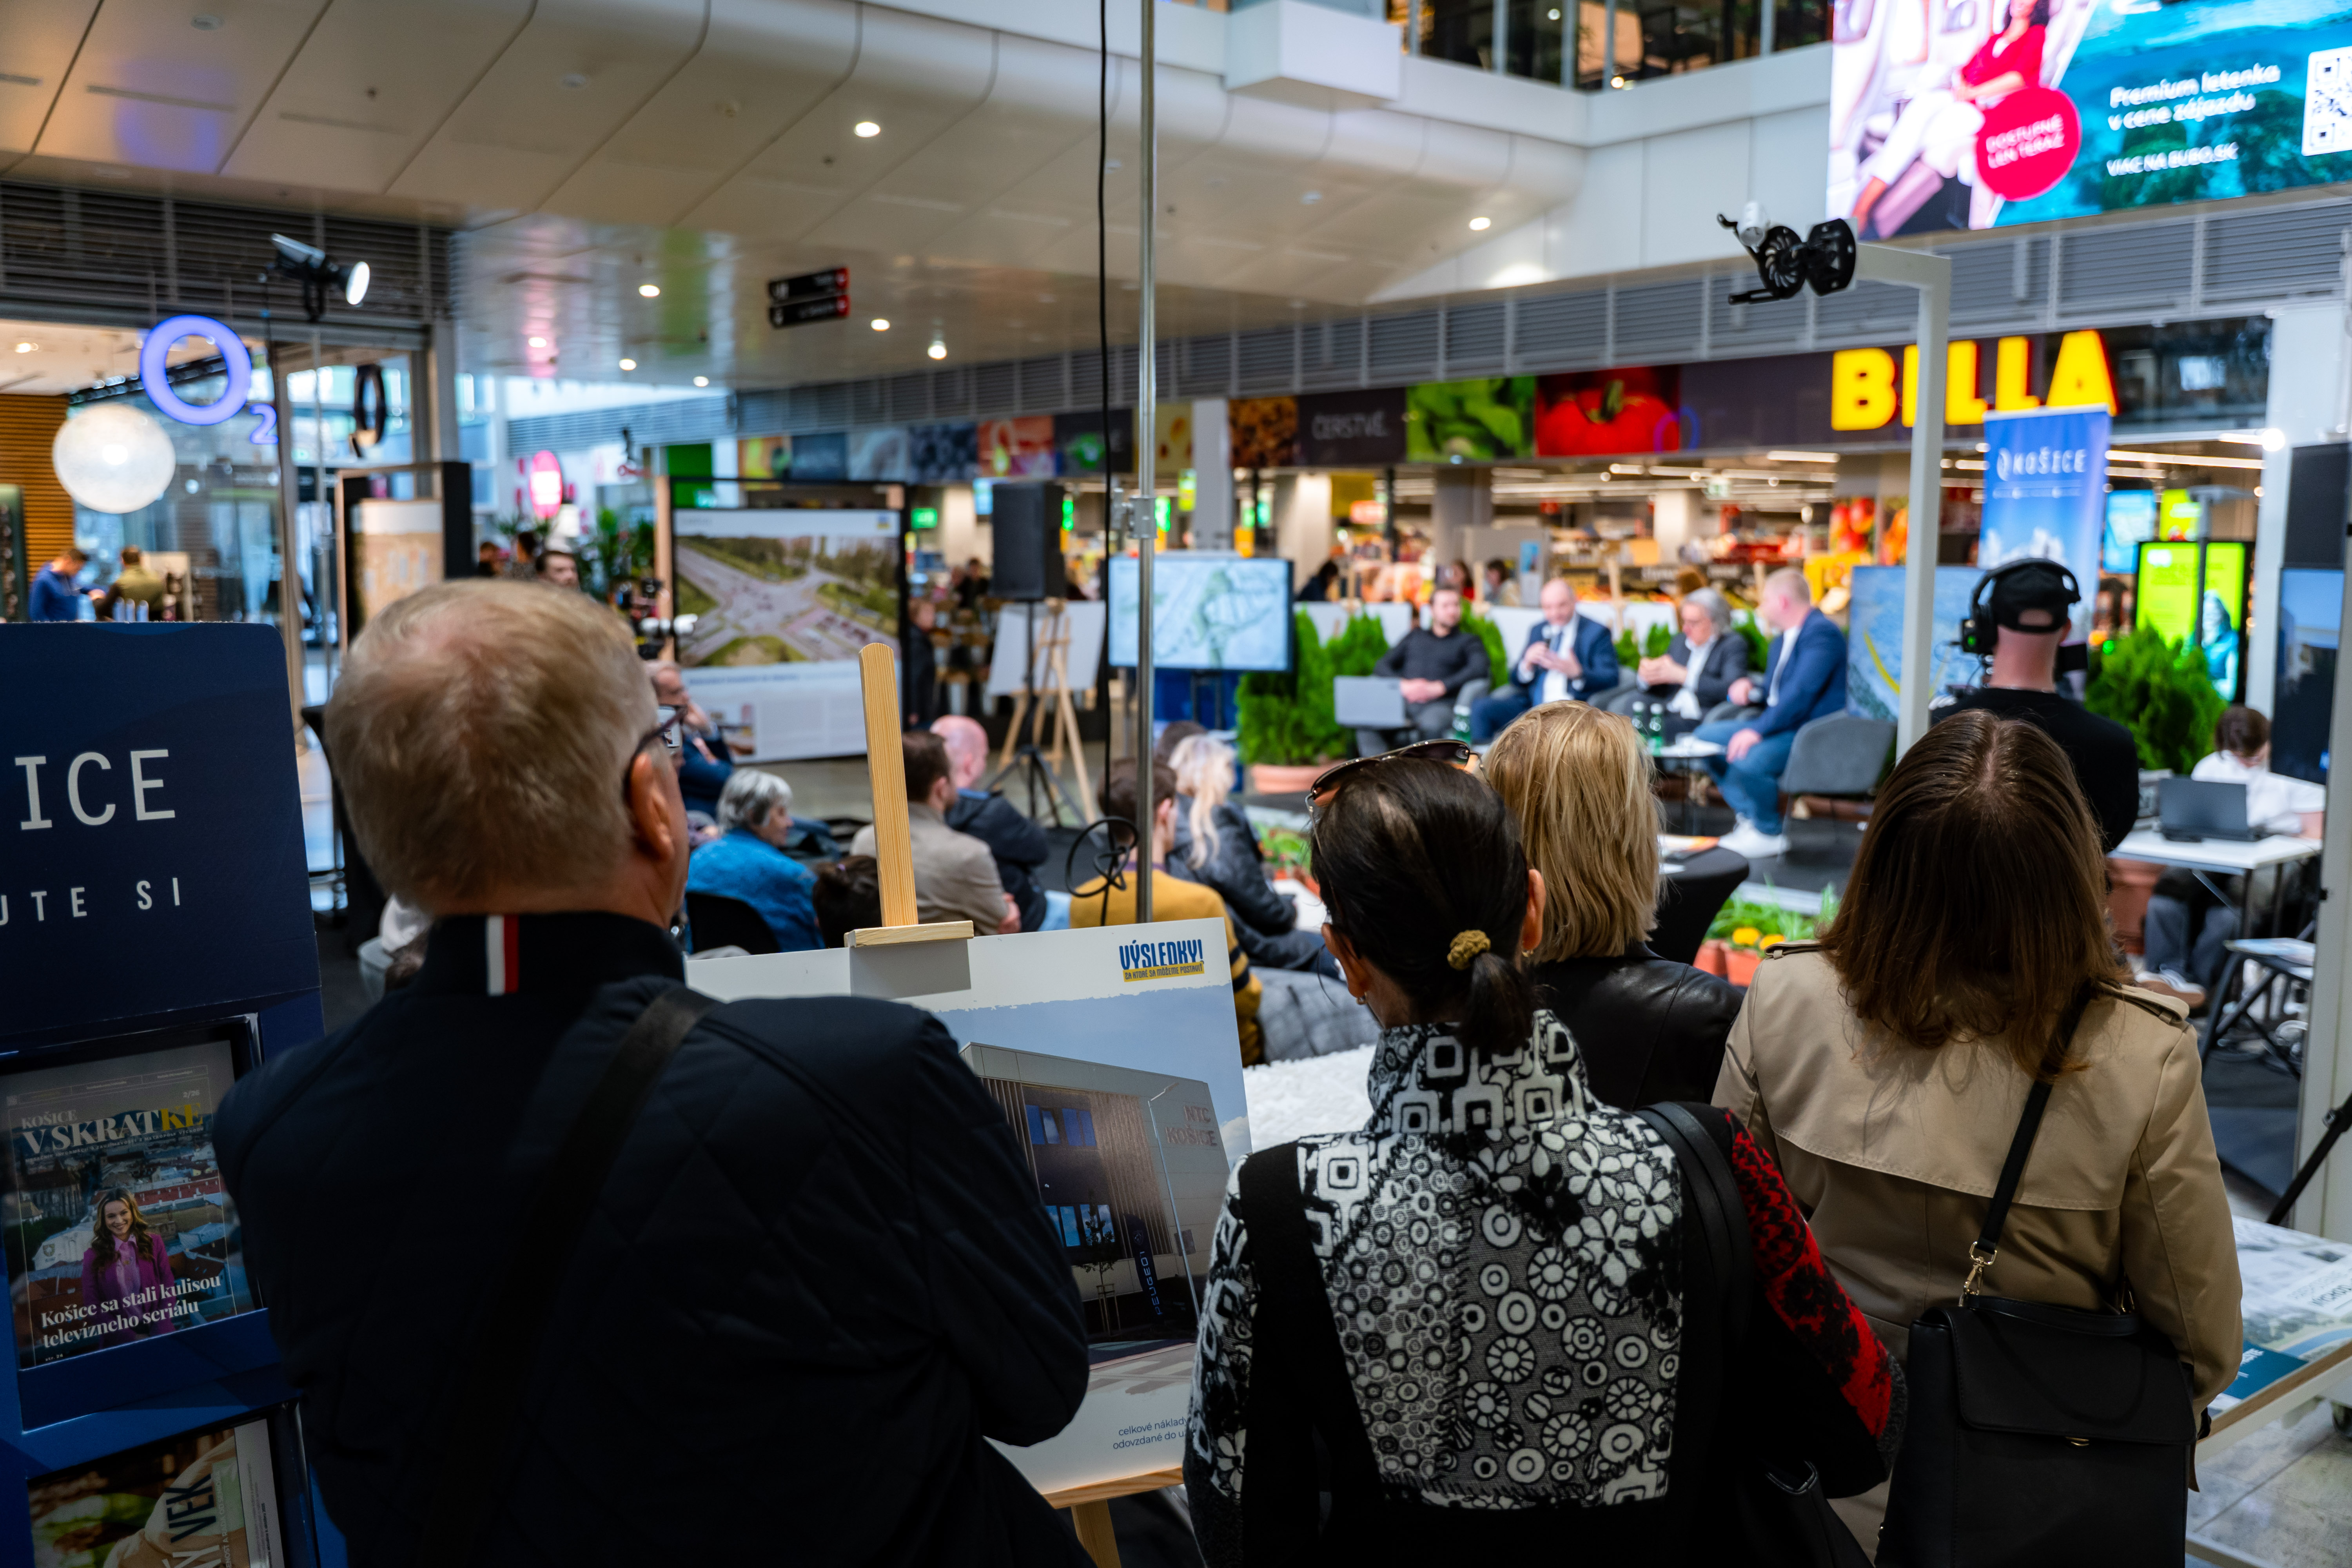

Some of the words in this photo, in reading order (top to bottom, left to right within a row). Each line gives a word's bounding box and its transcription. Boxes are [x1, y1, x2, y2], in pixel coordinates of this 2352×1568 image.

[2110, 78, 2200, 108] Premium
[2201, 63, 2281, 93] letenka
[2108, 114, 2122, 131] v
[2123, 106, 2172, 129] cene
[2173, 90, 2256, 122] zájazdu
[2107, 156, 2143, 176] VIAC
[2144, 152, 2168, 171] NA
[1831, 328, 2119, 430] BILLA
[15, 749, 175, 830] ICE
[136, 878, 180, 909] SI
[1119, 939, 1204, 971] VÝSLEDKY!
[1133, 969, 1148, 979] KTORÉ
[1157, 967, 1179, 976] MÔŽEME
[1180, 963, 1203, 974] POSTAVIŤ
[22, 1110, 78, 1129] KOŠICE
[22, 1128, 47, 1154] V
[51, 1102, 203, 1150] SKRATKE
[1183, 1105, 1211, 1123] NTC
[1165, 1124, 1218, 1147] KOŠICE
[41, 1304, 97, 1328] Košice
[101, 1299, 119, 1313] sa
[122, 1286, 158, 1308] stali
[160, 1276, 221, 1299] kulisou
[43, 1314, 139, 1348] televízneho
[143, 1299, 200, 1324] seriálu
[1113, 1433, 1162, 1449] odovzdané
[1165, 1431, 1176, 1439] do
[1119, 1422, 1152, 1436] celkové
[165, 1473, 216, 1543] VEK
